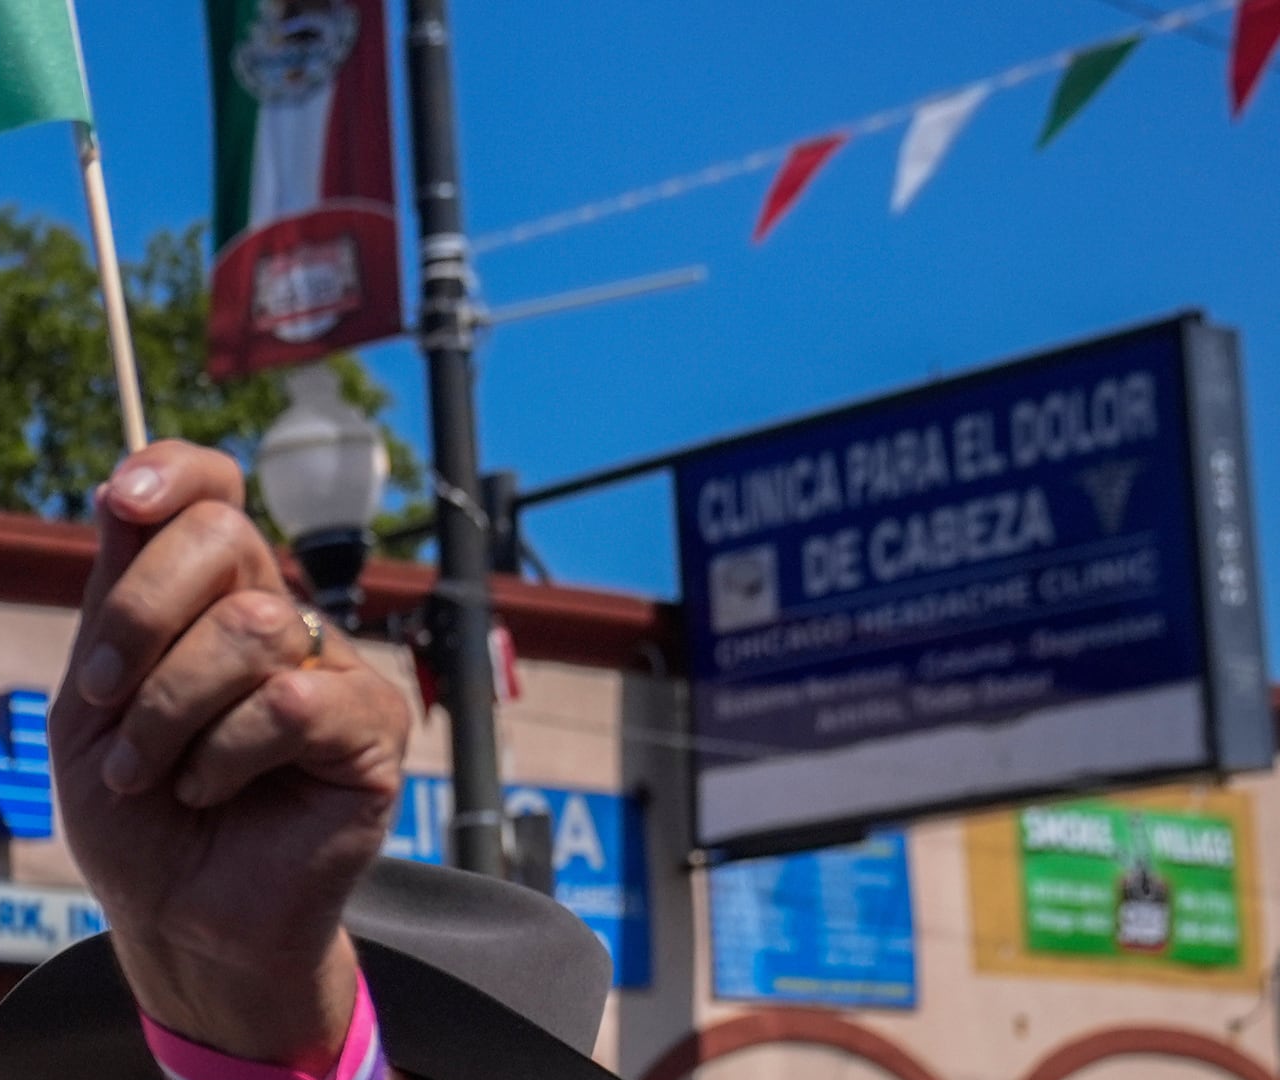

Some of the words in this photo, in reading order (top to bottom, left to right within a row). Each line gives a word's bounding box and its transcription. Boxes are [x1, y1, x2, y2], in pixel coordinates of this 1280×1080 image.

[697, 449, 842, 546] CLINICA
[844, 423, 949, 508] PARA
[952, 408, 1010, 481] EL
[1011, 371, 1160, 469] DOLOR
[801, 524, 864, 597] DE
[868, 485, 1056, 584] CABEZA
